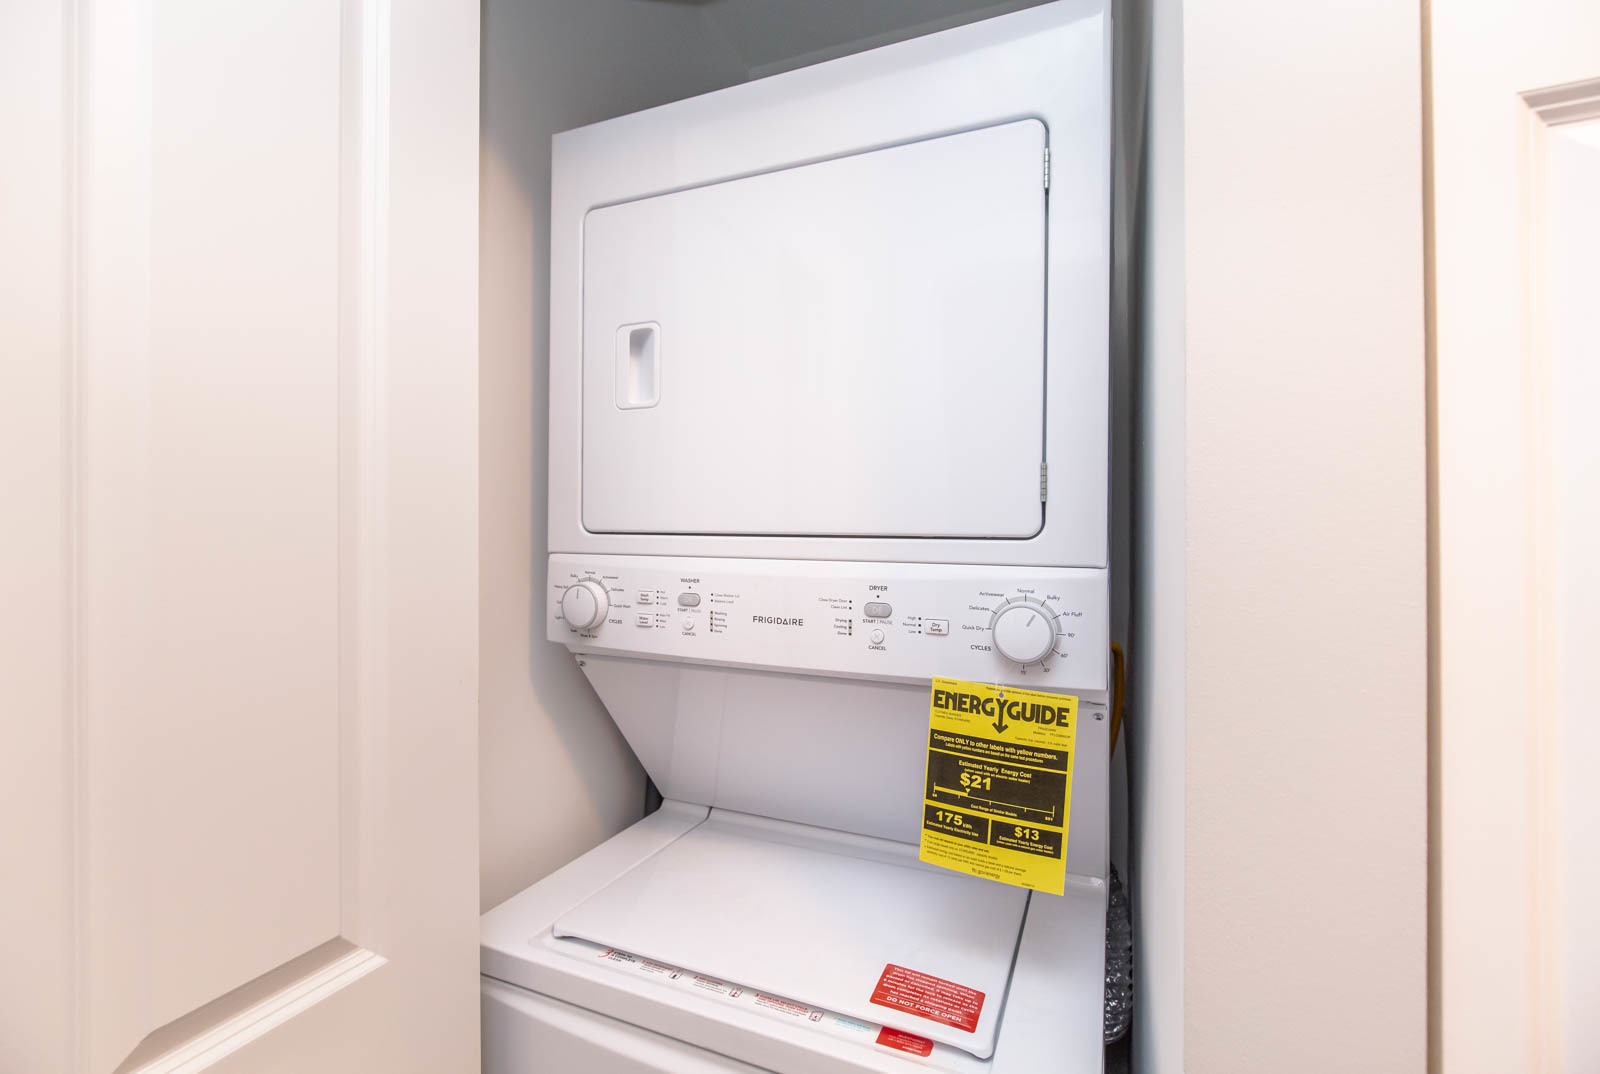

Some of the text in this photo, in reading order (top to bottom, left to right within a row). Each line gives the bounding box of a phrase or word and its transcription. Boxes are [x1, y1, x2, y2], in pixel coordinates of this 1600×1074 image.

[753, 615, 804, 627] FRIGIDAIRE
[934, 733, 954, 742] Compare
[955, 737, 969, 745] ONLY
[1034, 752, 1058, 760] numbers.
[958, 760, 982, 769] Estimated
[983, 765, 999, 773] Yearly
[1001, 768, 1019, 777] Energy
[960, 772, 991, 790] $21
[936, 810, 963, 825] 175
[926, 820, 942, 828] Estimated
[954, 827, 971, 836] Electricity
[1014, 826, 1039, 840] $13
[999, 835, 1017, 843] Estimated
[899, 999, 913, 1007] NOT
[915, 1004, 939, 1015] FORCE
[941, 1012, 962, 1022] OPEN
